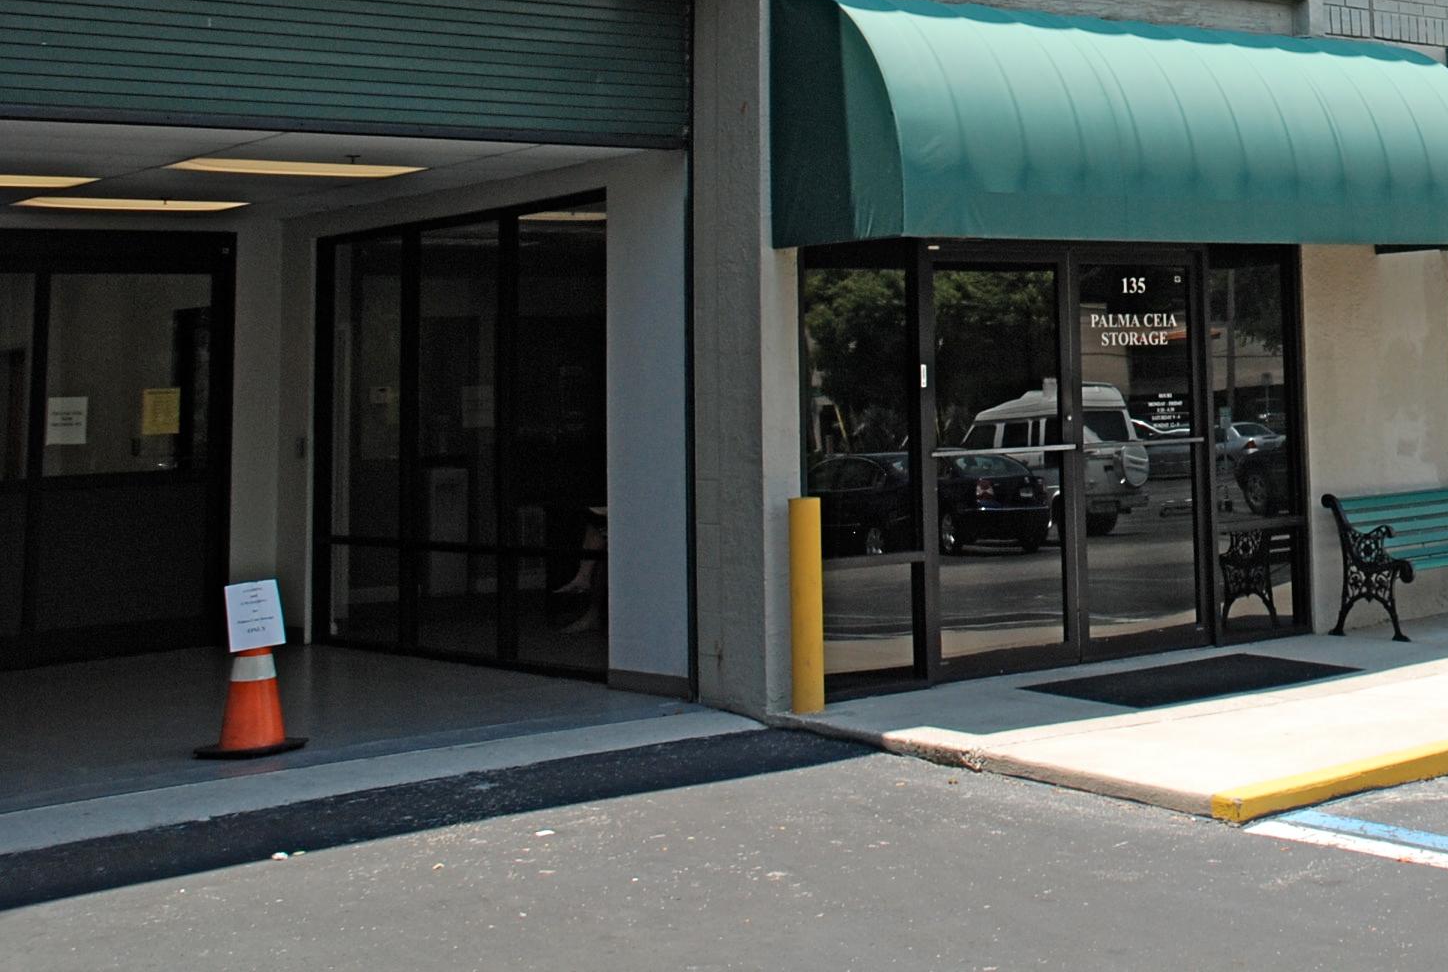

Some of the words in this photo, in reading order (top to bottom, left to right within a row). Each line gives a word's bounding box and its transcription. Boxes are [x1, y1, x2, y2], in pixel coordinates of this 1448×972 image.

[1121, 276, 1146, 294] 135
[1090, 313, 1141, 328] PALMA
[1143, 313, 1178, 328] CEIA
[1101, 331, 1169, 346] STORAGE
